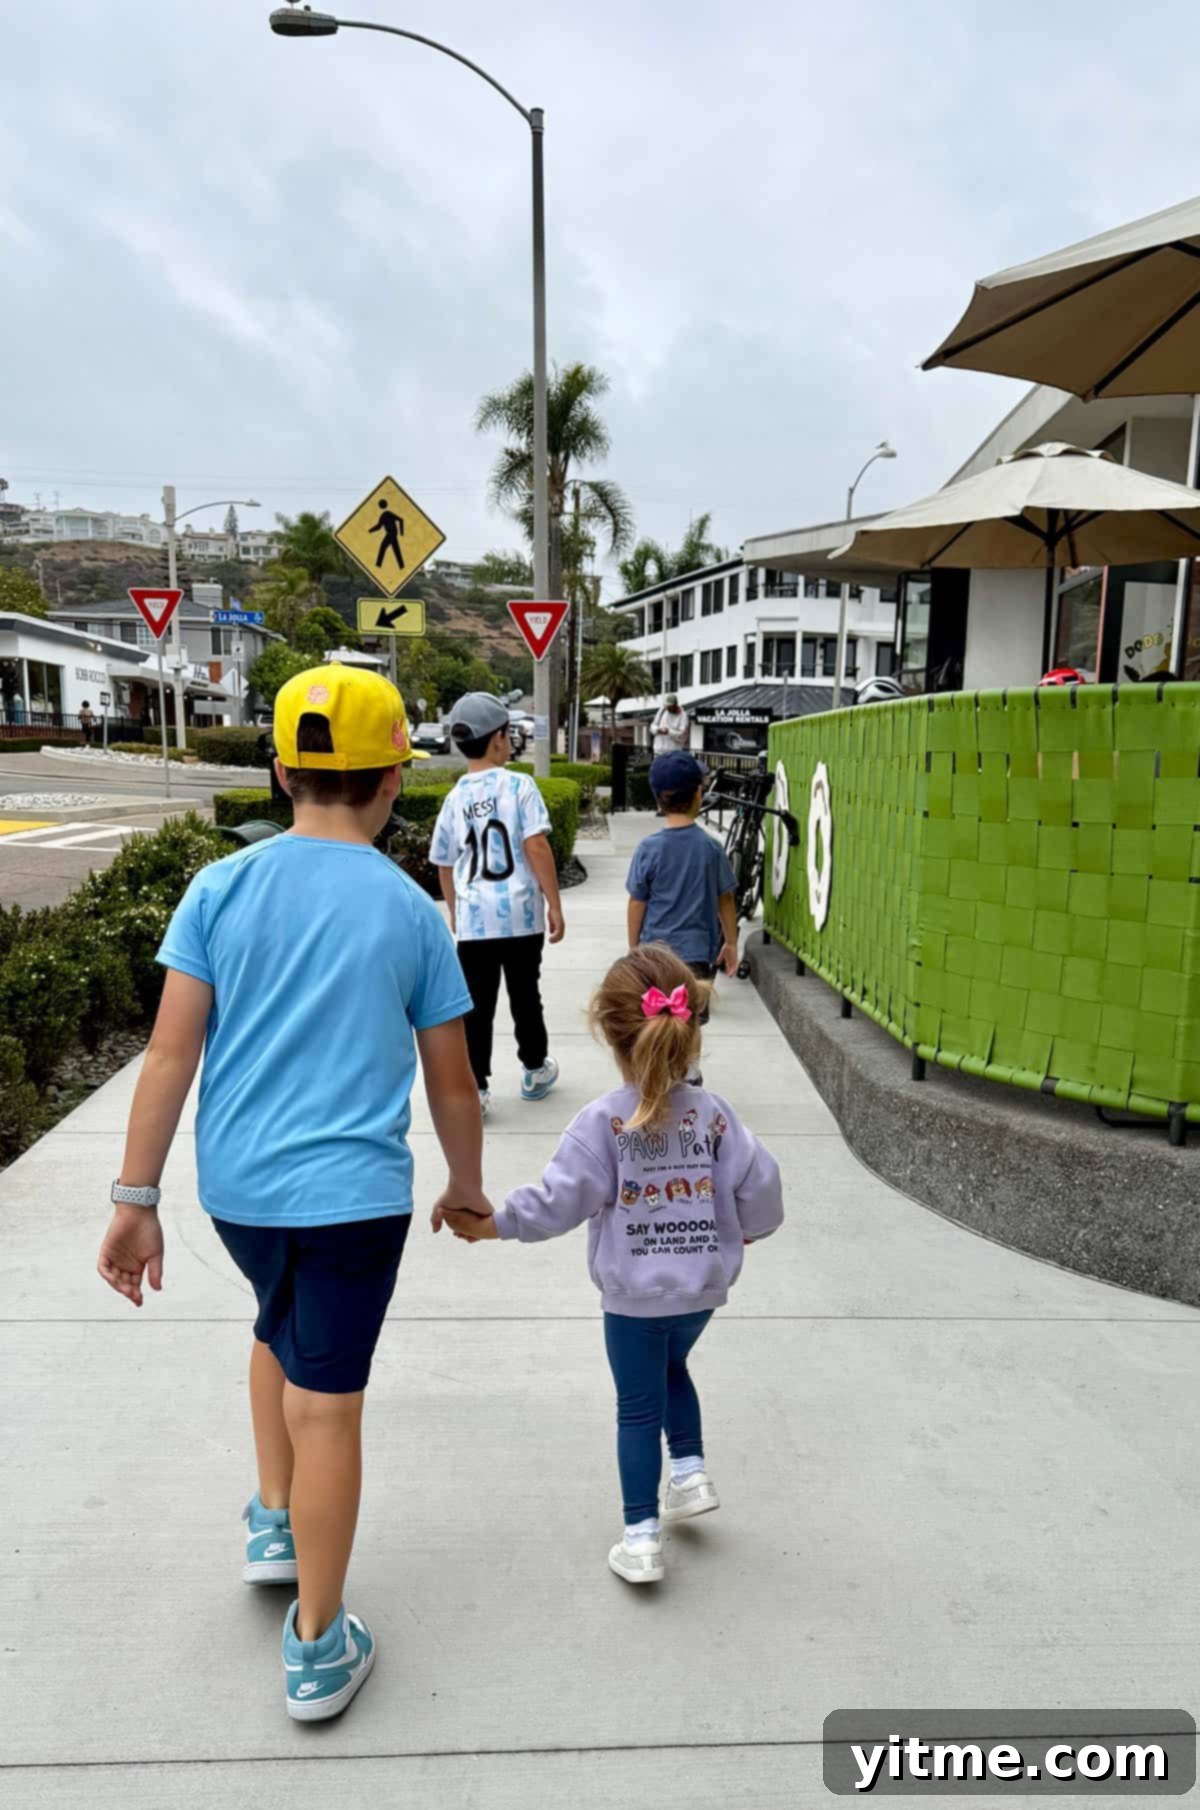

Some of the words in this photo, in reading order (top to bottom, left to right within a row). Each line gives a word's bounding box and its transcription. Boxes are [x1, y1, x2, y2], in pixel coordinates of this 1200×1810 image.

[229, 612, 248, 621] JOLLA
[529, 615, 548, 624] YIELD
[715, 709, 726, 717] LA
[727, 709, 751, 717] JOLLA
[463, 796, 497, 820] MESSI
[464, 818, 514, 884] 10
[616, 1131, 668, 1162] PAW
[626, 1223, 650, 1236] SAY
[644, 1238, 657, 1246] ON
[660, 1236, 686, 1246] LAND
[689, 1235, 710, 1244] AND
[631, 1247, 649, 1257] YOU
[652, 1246, 671, 1254] CAN
[673, 1244, 704, 1255] COUNT
